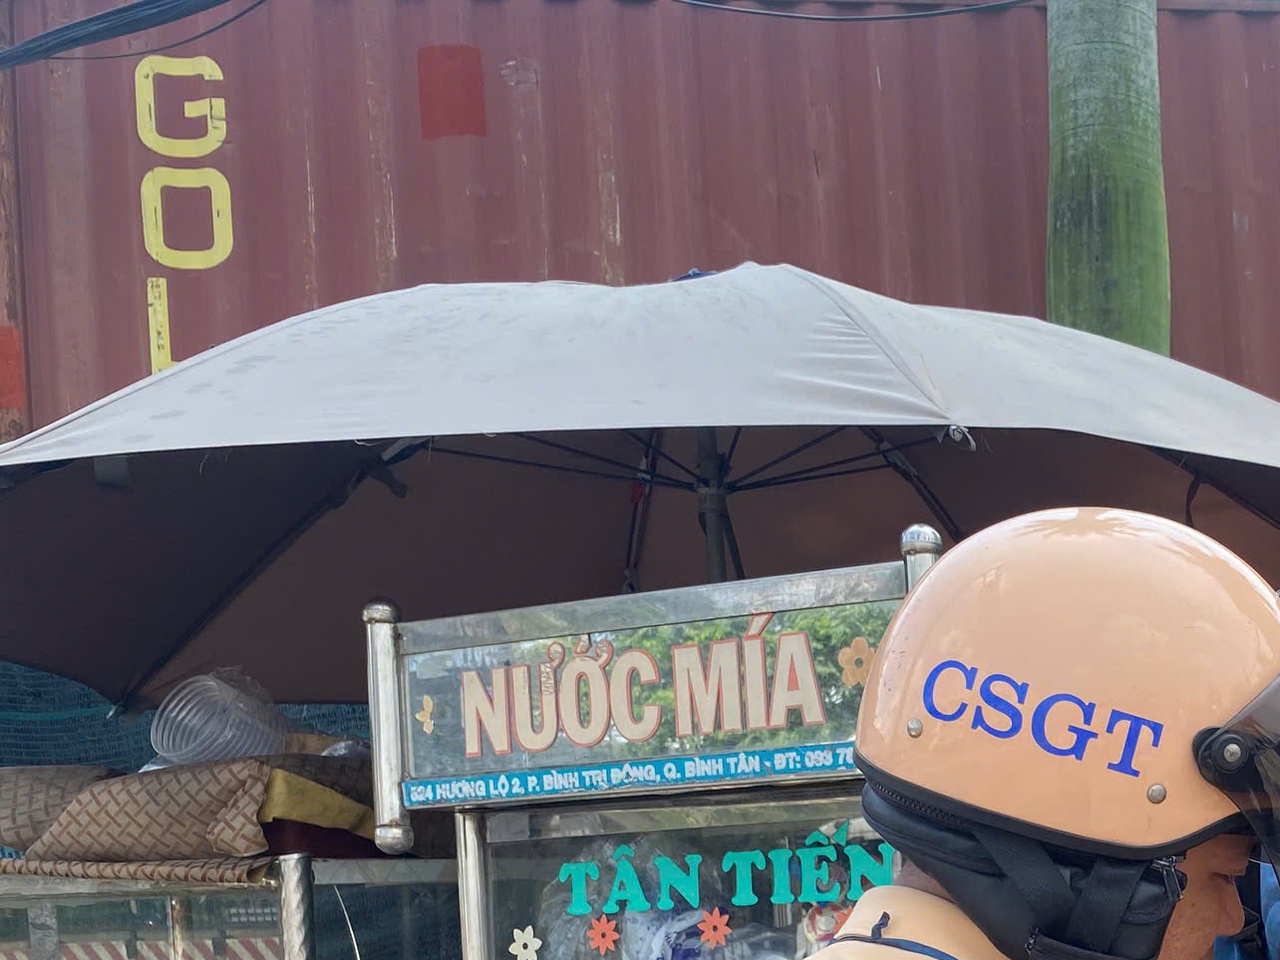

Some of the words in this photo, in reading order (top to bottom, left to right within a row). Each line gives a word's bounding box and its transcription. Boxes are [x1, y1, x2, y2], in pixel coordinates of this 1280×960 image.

[461, 632, 661, 757] NƯỚC
[672, 612, 827, 737] MÍA
[923, 660, 1164, 778] CSGT
[489, 774, 510, 798] LỘ
[511, 777, 525, 795] 2,
[527, 775, 541, 792] P.
[543, 769, 579, 791] BÌNH
[663, 762, 682, 781] Q.
[684, 756, 724, 778] BÌNH
[726, 751, 761, 774] TÂN
[774, 752, 801, 771] ĐT:
[558, 843, 703, 915] TÂN
[721, 818, 897, 906] TIẾN
